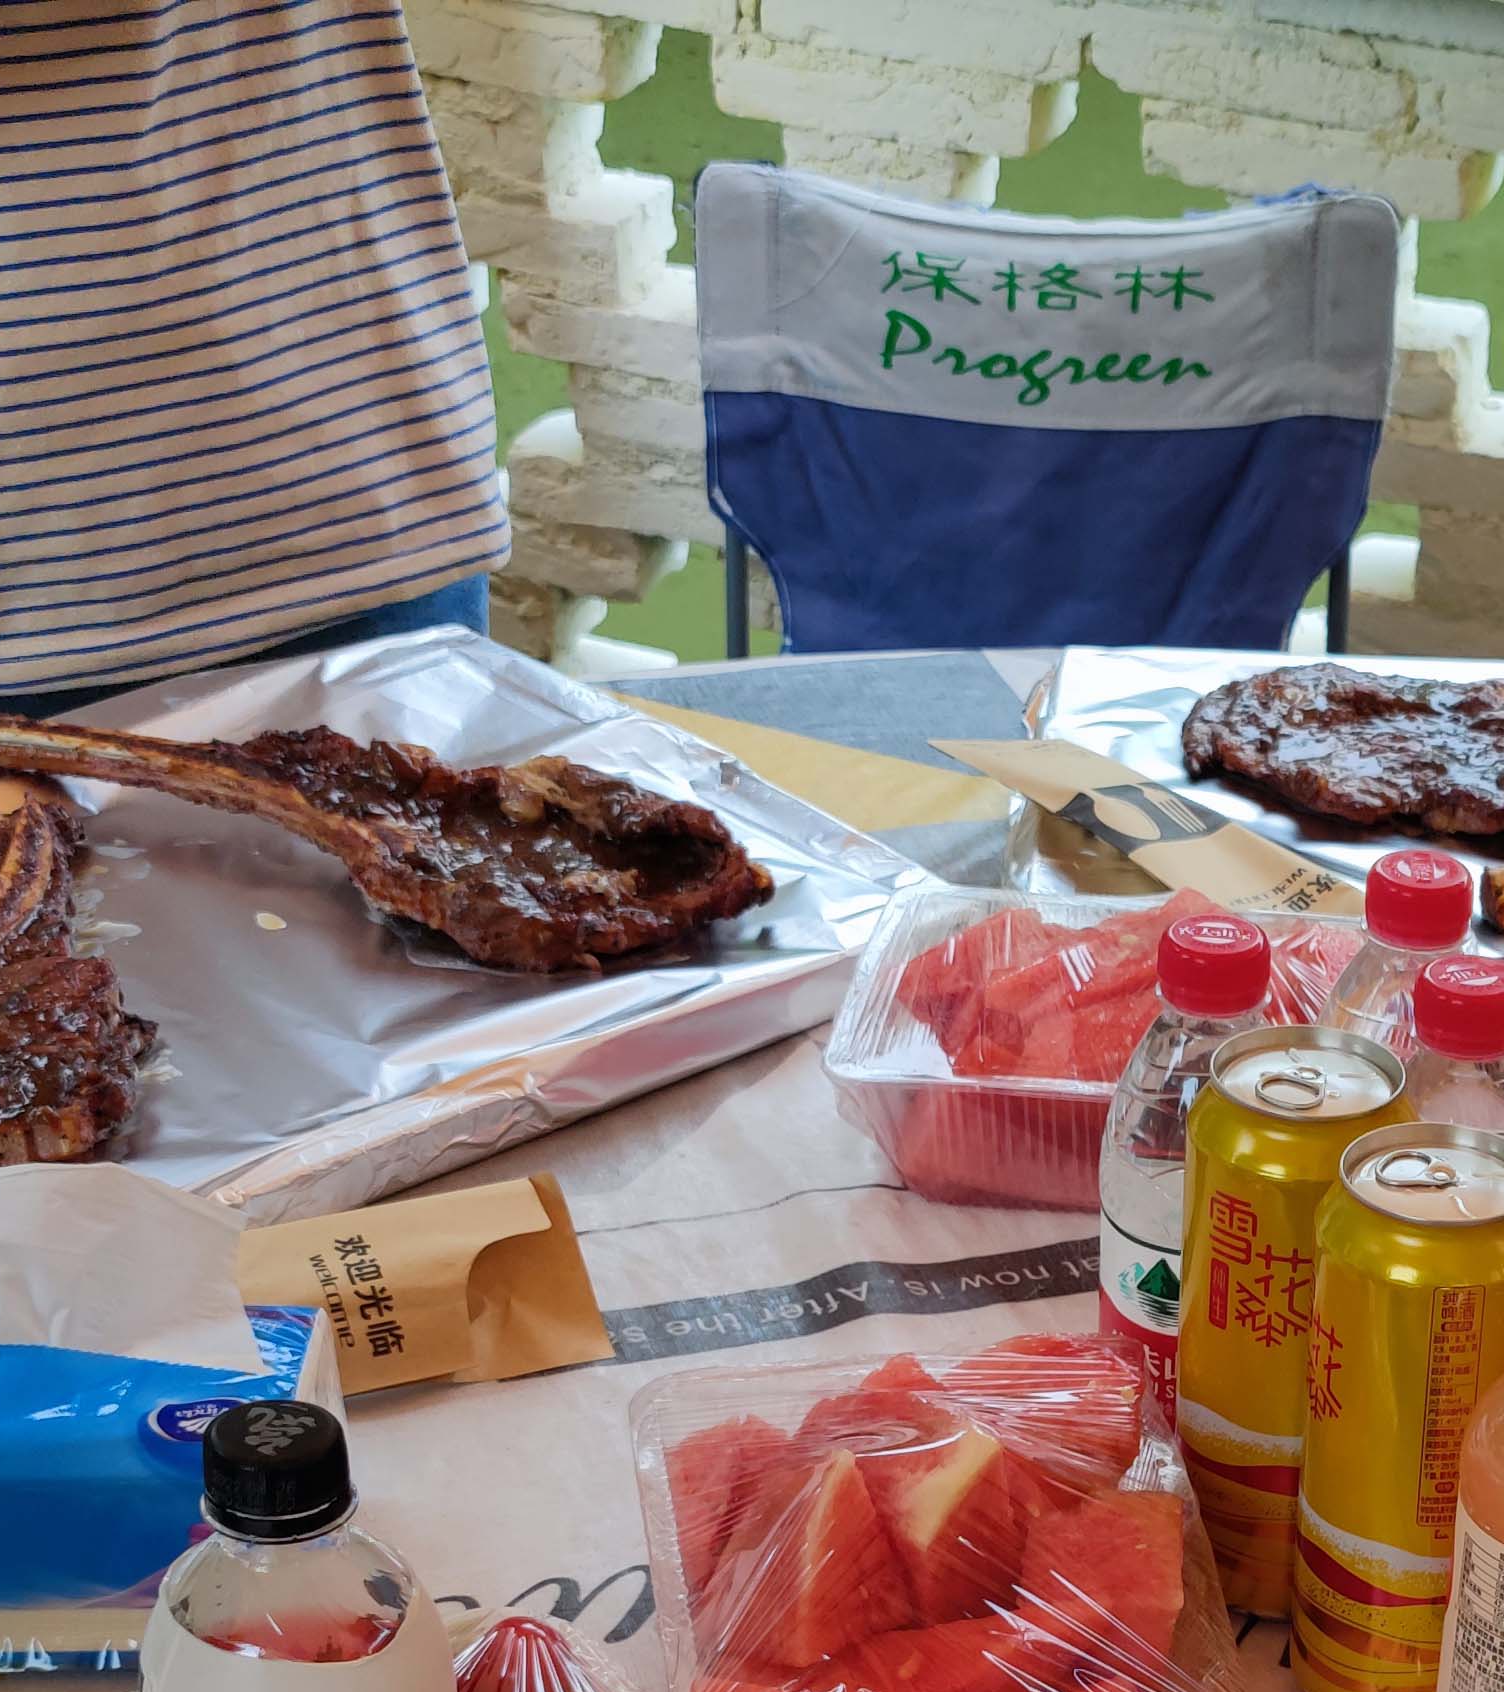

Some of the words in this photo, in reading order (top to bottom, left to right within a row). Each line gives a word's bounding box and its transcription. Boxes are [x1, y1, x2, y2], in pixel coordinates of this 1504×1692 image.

[881, 250, 1214, 313] 保格林
[880, 310, 1212, 405] Progreen
[1274, 872, 1336, 912] 欢迎
[960, 1264, 1049, 1291] now
[1060, 1257, 1101, 1281] at
[308, 1252, 356, 1348] welcome
[334, 1234, 406, 1357] 欢迎光临
[759, 1280, 869, 1323] After
[665, 1313, 742, 1337] the
